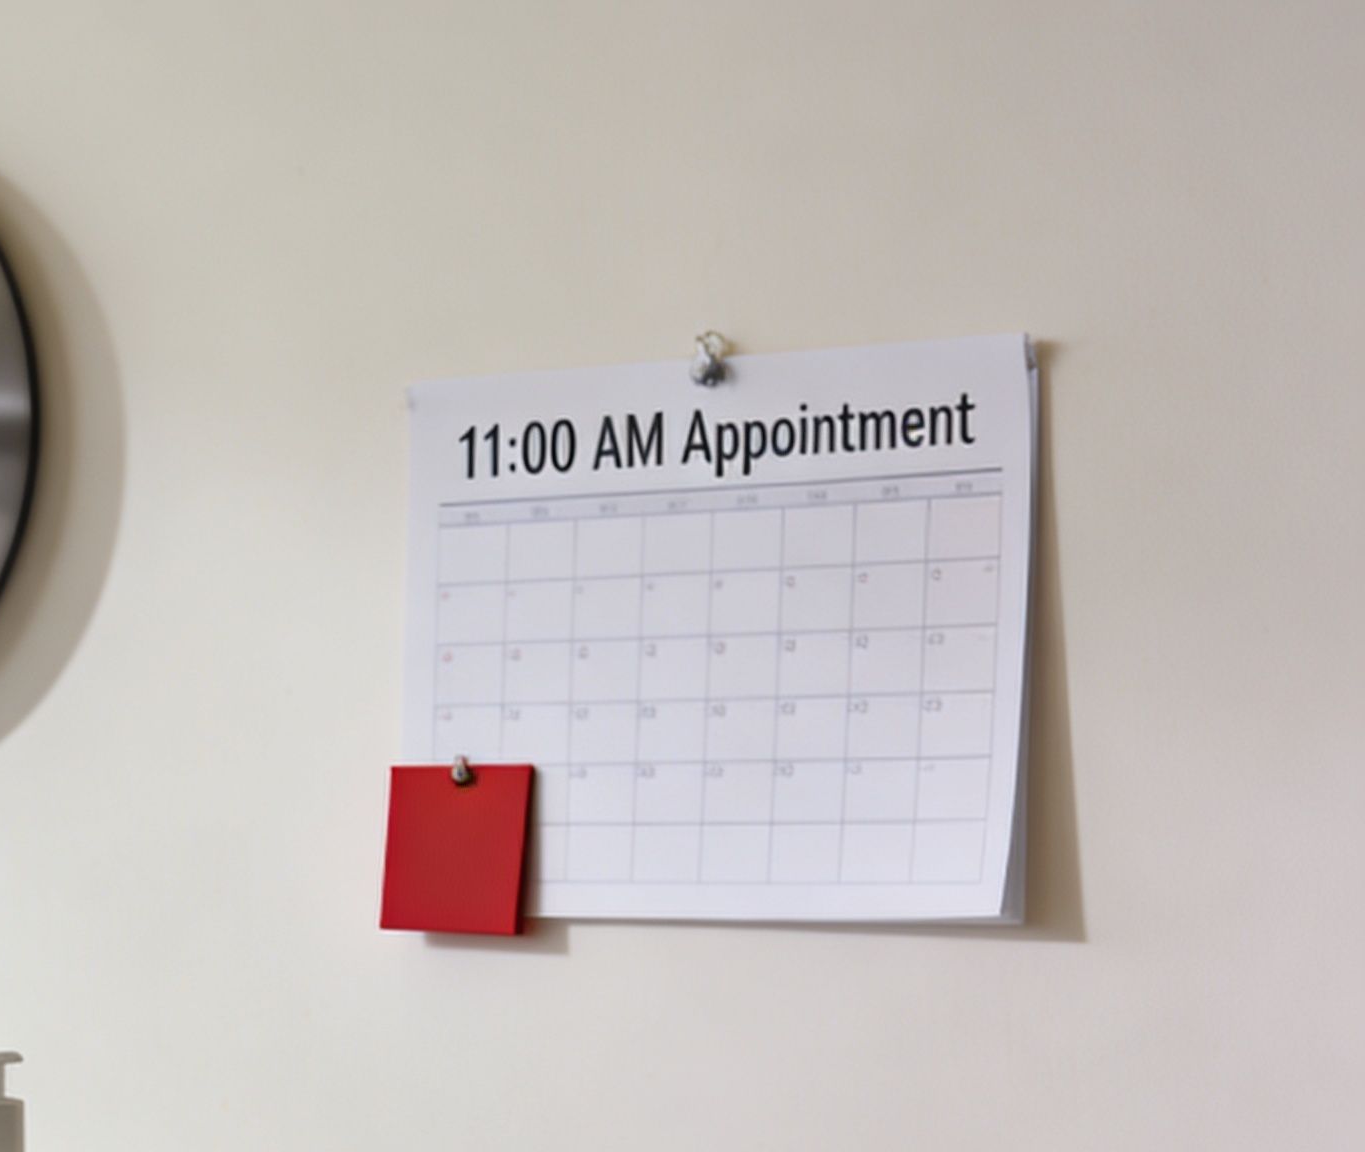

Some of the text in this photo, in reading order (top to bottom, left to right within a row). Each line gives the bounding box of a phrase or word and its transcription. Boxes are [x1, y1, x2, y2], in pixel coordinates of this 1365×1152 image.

[457, 392, 977, 481] 11:00 AM Appointment
